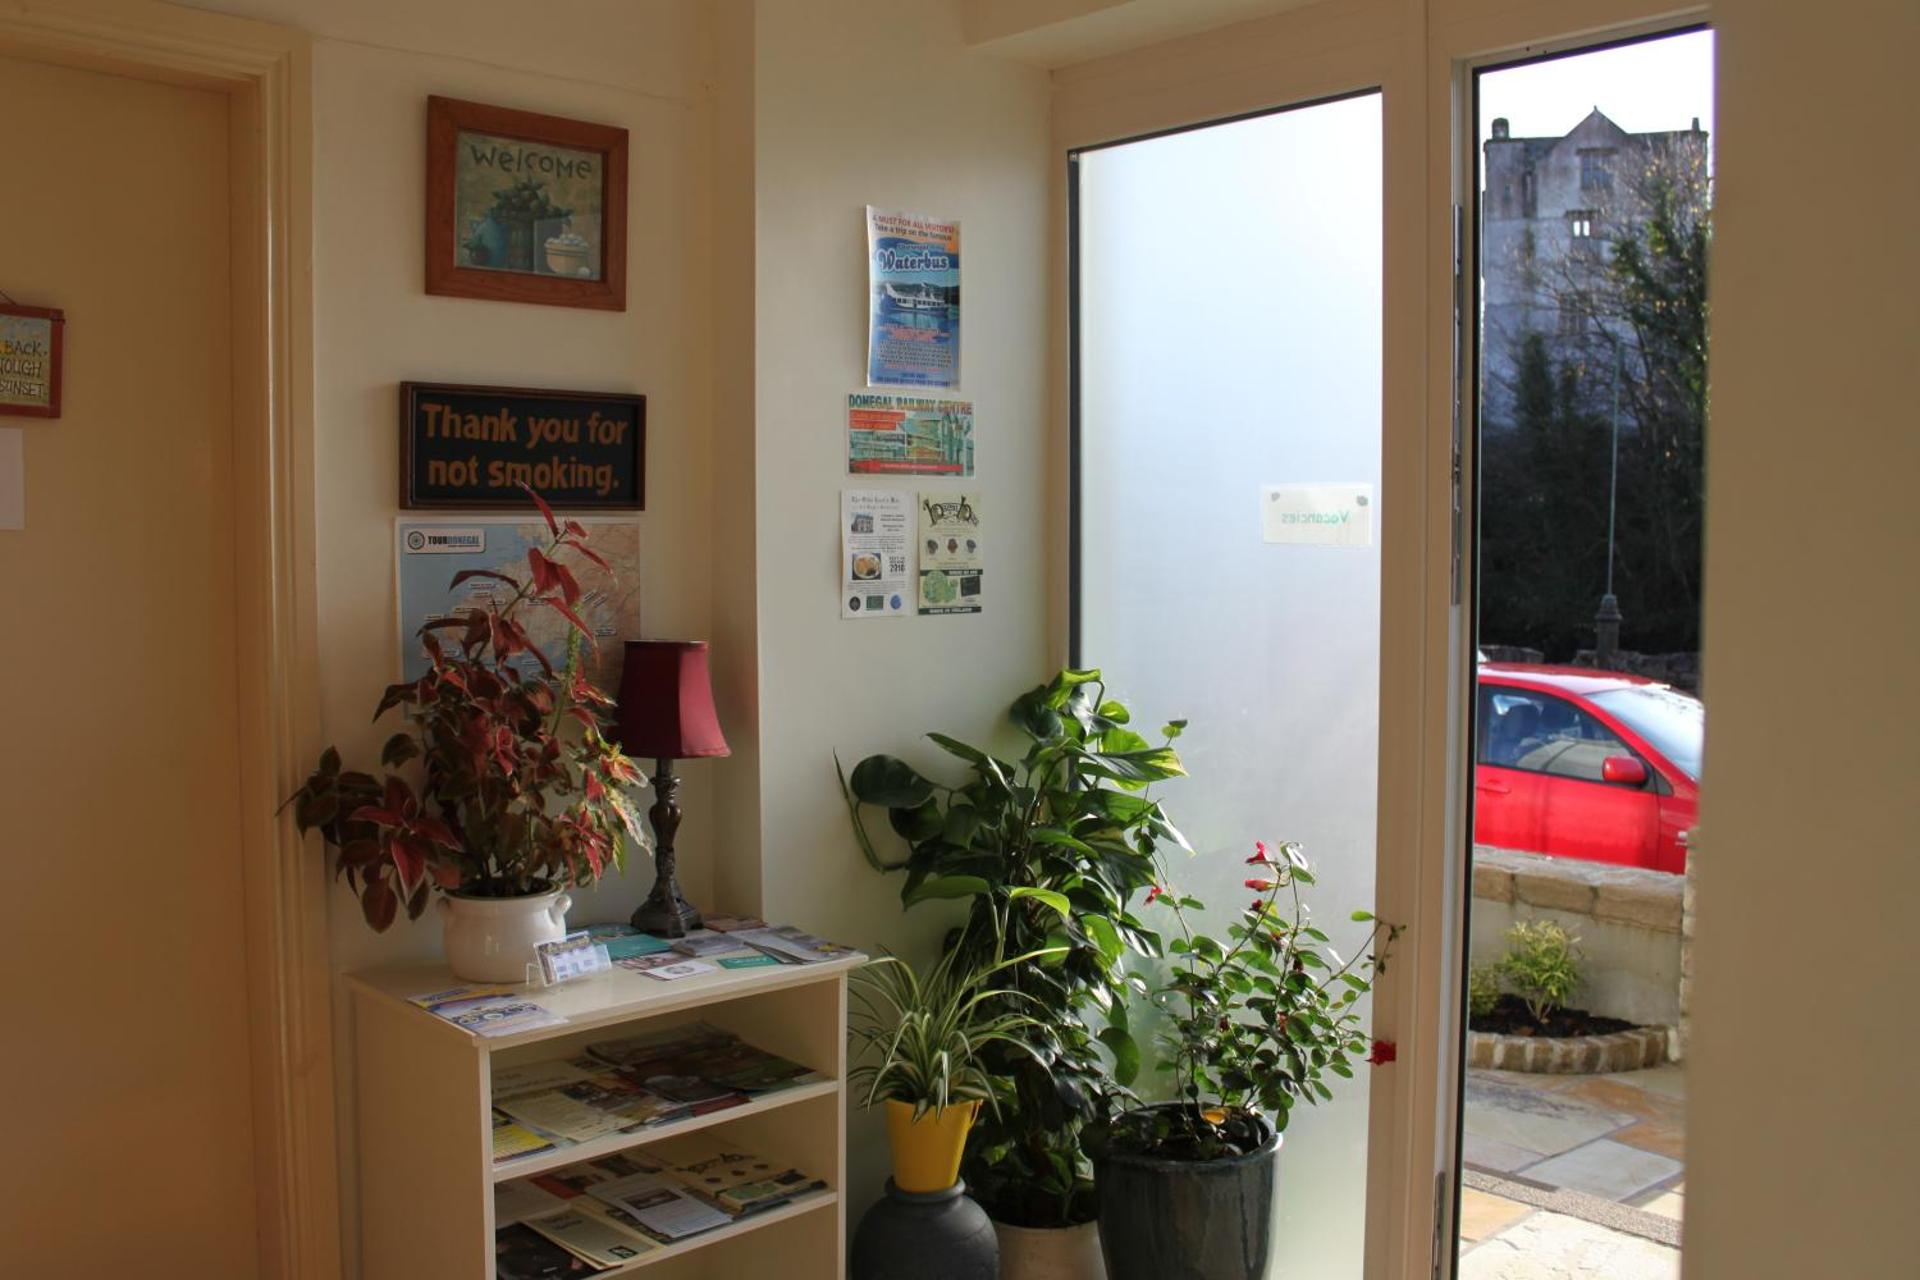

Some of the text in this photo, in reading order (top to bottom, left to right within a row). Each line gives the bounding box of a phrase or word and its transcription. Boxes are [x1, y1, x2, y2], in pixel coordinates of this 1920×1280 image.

[876, 248, 949, 273] Waterbus
[849, 394, 972, 415] DONEGAL RAILWAY CENTRE
[421, 402, 628, 449] Thank you for
[428, 454, 619, 496] not smoking.
